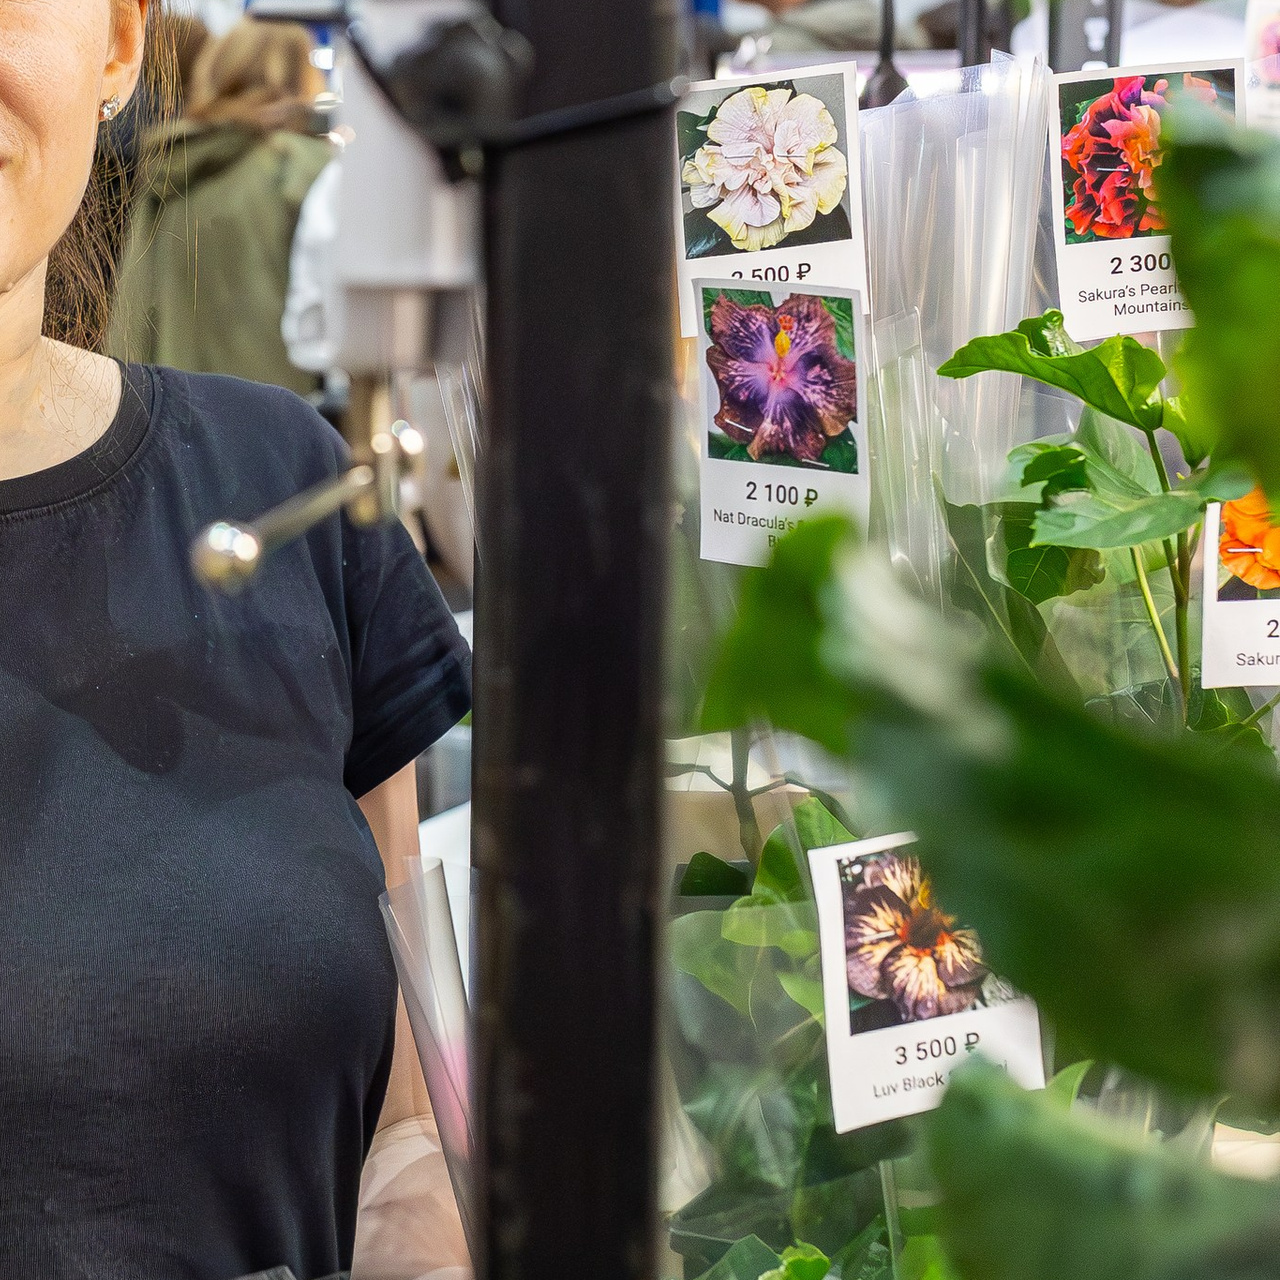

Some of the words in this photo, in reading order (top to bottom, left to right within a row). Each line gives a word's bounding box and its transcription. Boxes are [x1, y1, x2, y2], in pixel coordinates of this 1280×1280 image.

[752, 265, 790, 282] 500
[1110, 256, 1124, 275] 2
[1130, 252, 1171, 272] 300
[1078, 284, 1136, 303] Sakura's
[746, 481, 757, 500] 2
[764, 483, 799, 505] 100
[713, 508, 734, 524] Nat
[737, 511, 795, 531] Dracula's
[1266, 619, 1280, 638] 2
[895, 1046, 908, 1065] 3
[916, 1036, 957, 1061] 500
[872, 1083, 899, 1098] Luv
[903, 1072, 945, 1092] Black
